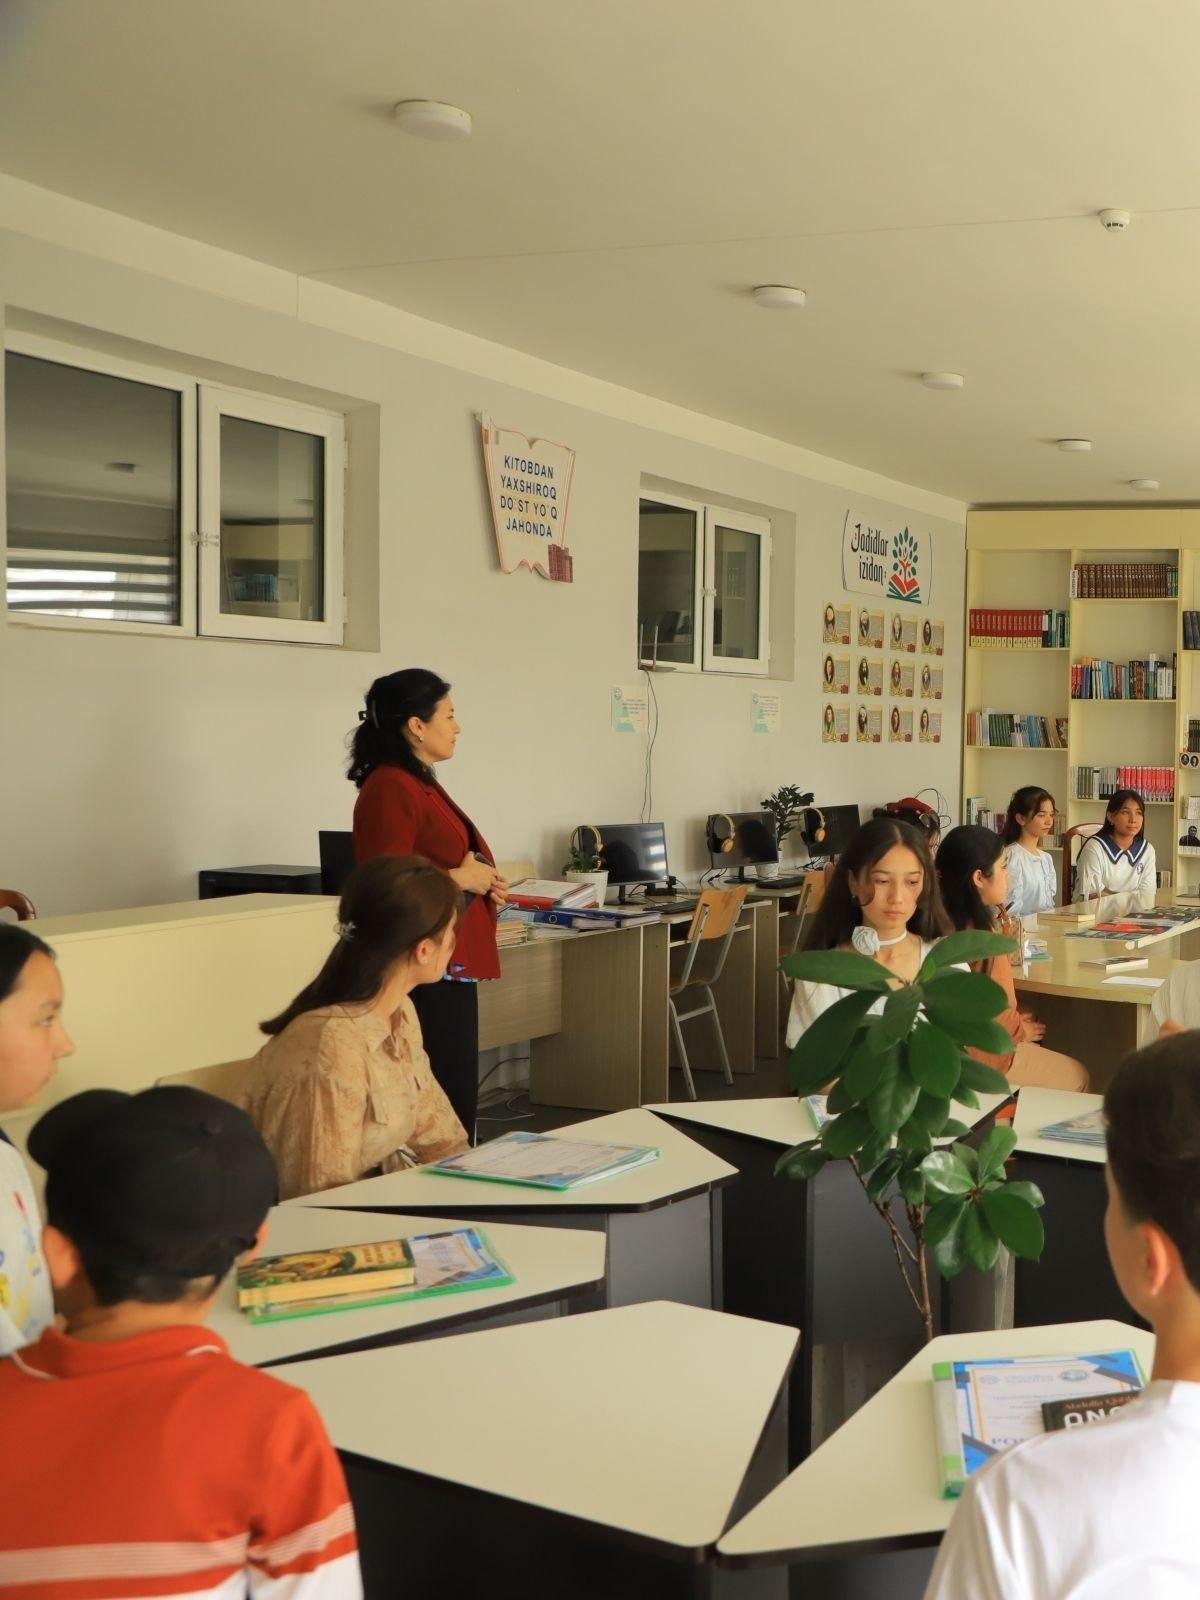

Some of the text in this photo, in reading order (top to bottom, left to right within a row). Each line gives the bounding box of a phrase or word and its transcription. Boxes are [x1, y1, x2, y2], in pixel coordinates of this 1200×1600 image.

[504, 455, 553, 479] KITOBDAN
[500, 475, 557, 500] YAXSHIROQ
[506, 518, 552, 537] JAHONDA
